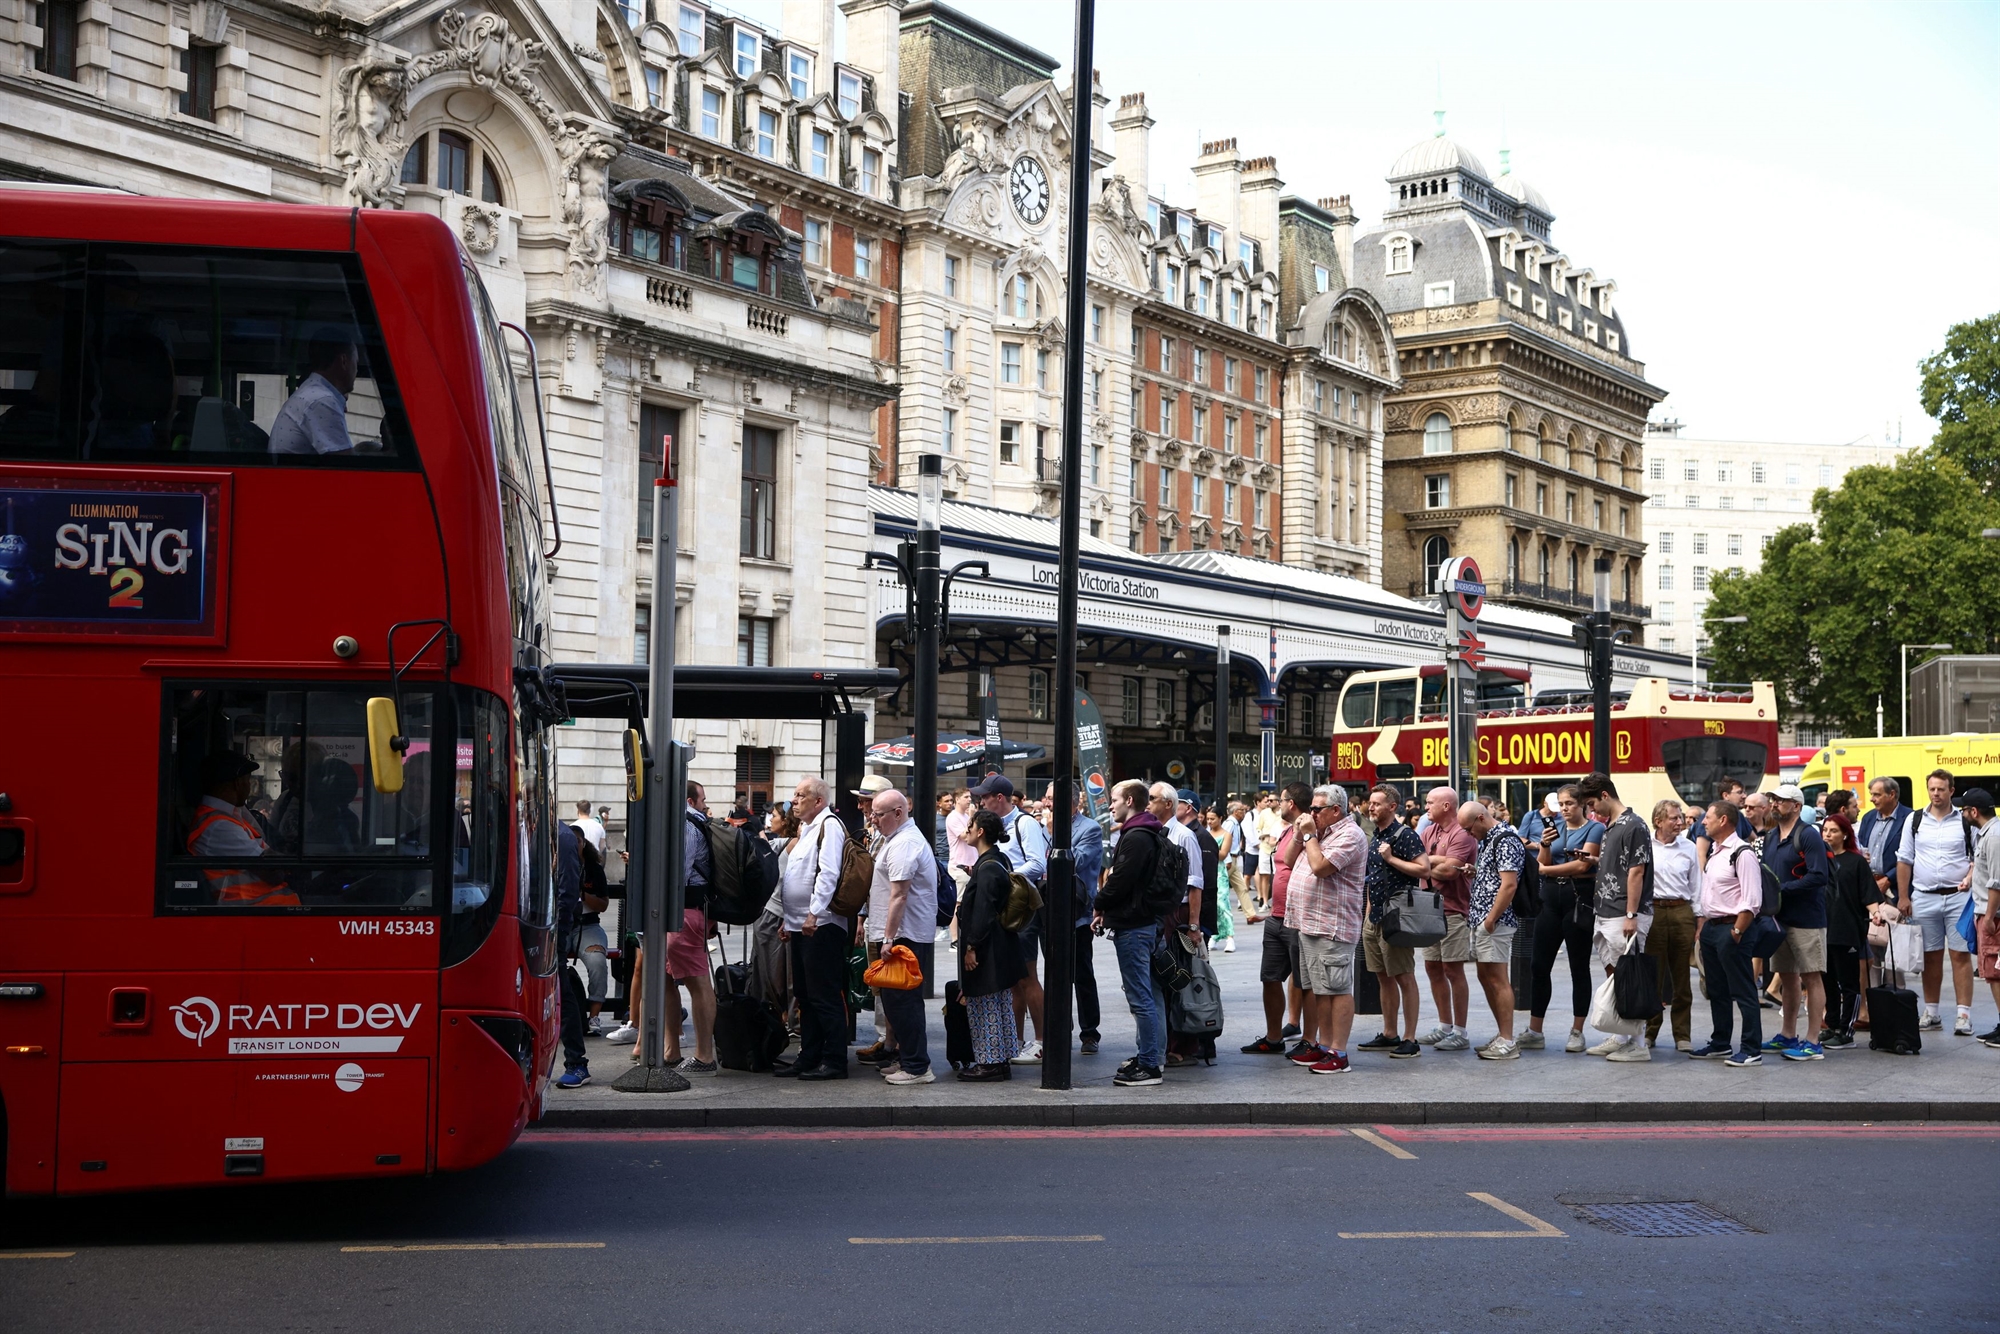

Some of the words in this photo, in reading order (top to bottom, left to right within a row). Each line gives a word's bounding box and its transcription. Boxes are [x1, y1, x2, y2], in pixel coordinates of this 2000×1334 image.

[70, 504, 138, 518] ILLUMINATION
[55, 522, 192, 576] SING
[108, 568, 145, 610] 2
[1033, 565, 1058, 585] Lon
[1079, 572, 1120, 594] Victoria
[1122, 578, 1158, 599] Station
[1456, 582, 1485, 594] UNDERGROUND
[1374, 620, 1402, 636] London
[1402, 624, 1428, 640] Victoria
[1635, 660, 1651, 673] Station
[457, 747, 473, 756] isito
[1338, 742, 1351, 757] BIG
[1497, 731, 1591, 765] LONDON
[1233, 753, 1250, 767] M&S
[1252, 754, 1280, 767] SIY
[1282, 755, 1304, 768] FOOD
[1338, 757, 1351, 770] BUS
[1937, 754, 1982, 766] Emergency
[339, 921, 380, 935] VMH
[384, 921, 434, 935] 45343
[228, 1004, 329, 1030] RATP
[233, 1042, 285, 1051] TRANSIT
[289, 1041, 340, 1050] LONDON
